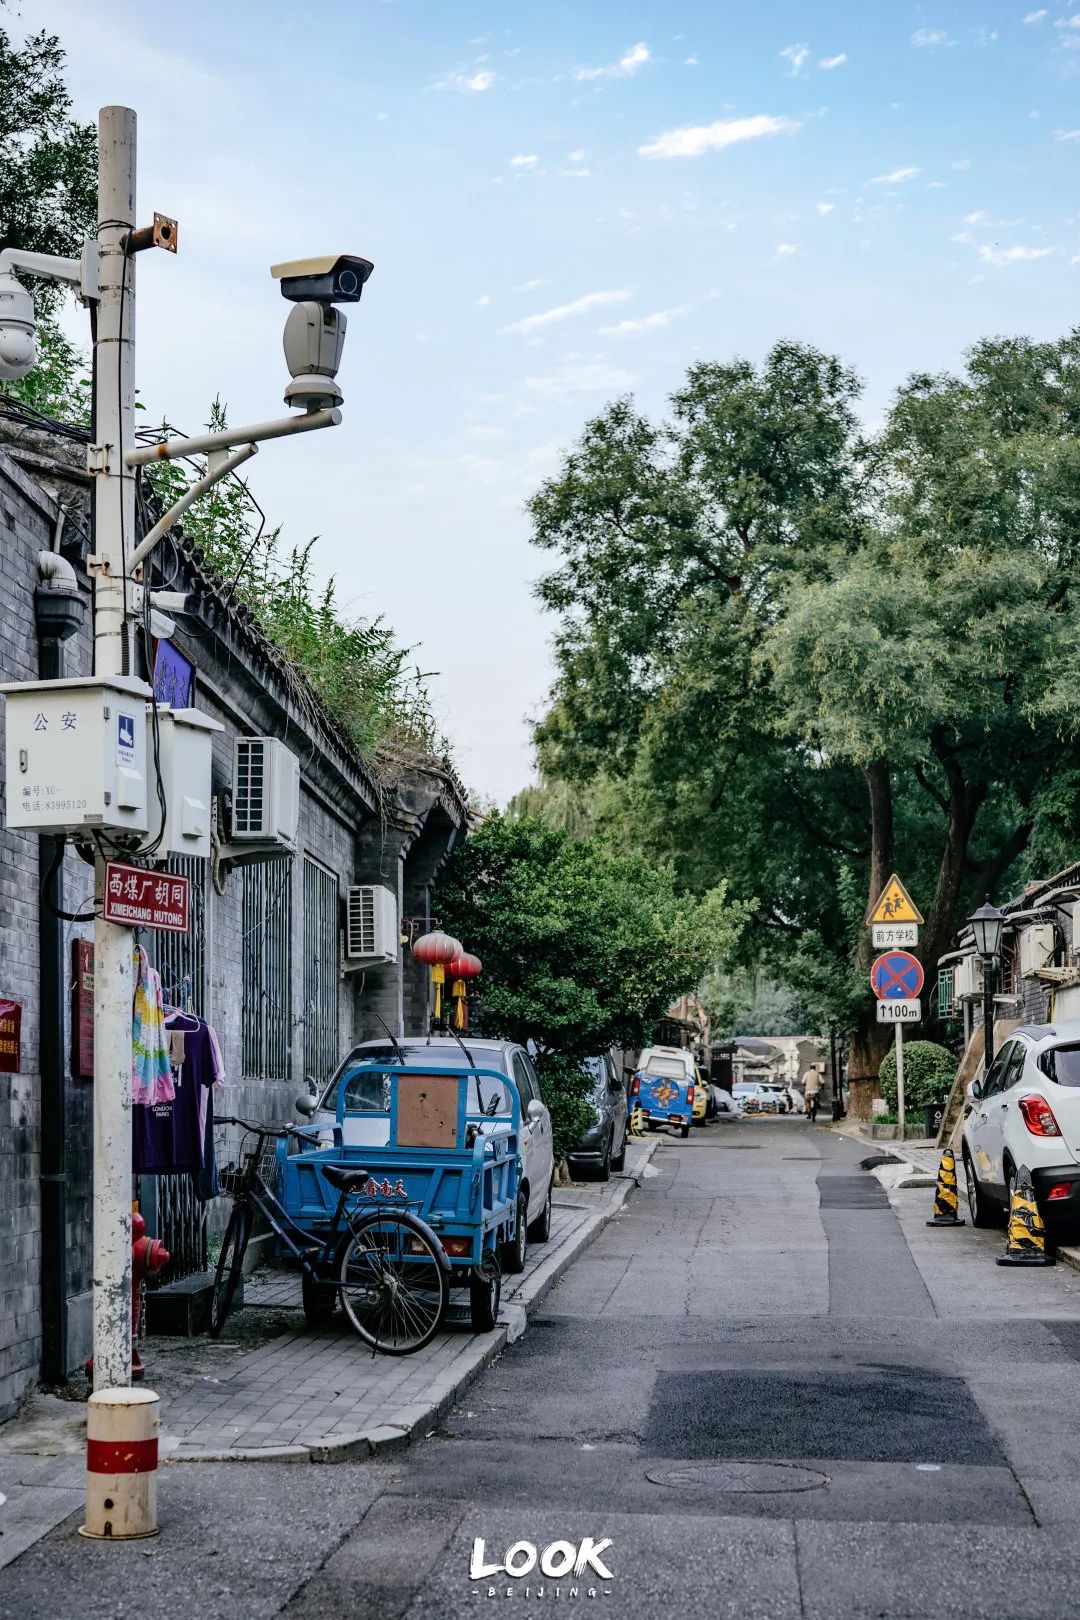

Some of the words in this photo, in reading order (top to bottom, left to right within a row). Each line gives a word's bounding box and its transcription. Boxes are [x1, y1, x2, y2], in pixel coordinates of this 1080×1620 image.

[33, 711, 77, 731] 公安
[109, 873, 184, 908] 西煤厂胡同
[110, 902, 152, 920] XIMEICHANG
[153, 910, 183, 925] HUTONG
[876, 929, 914, 942] 前方学校
[888, 1005, 917, 1017] 100m
